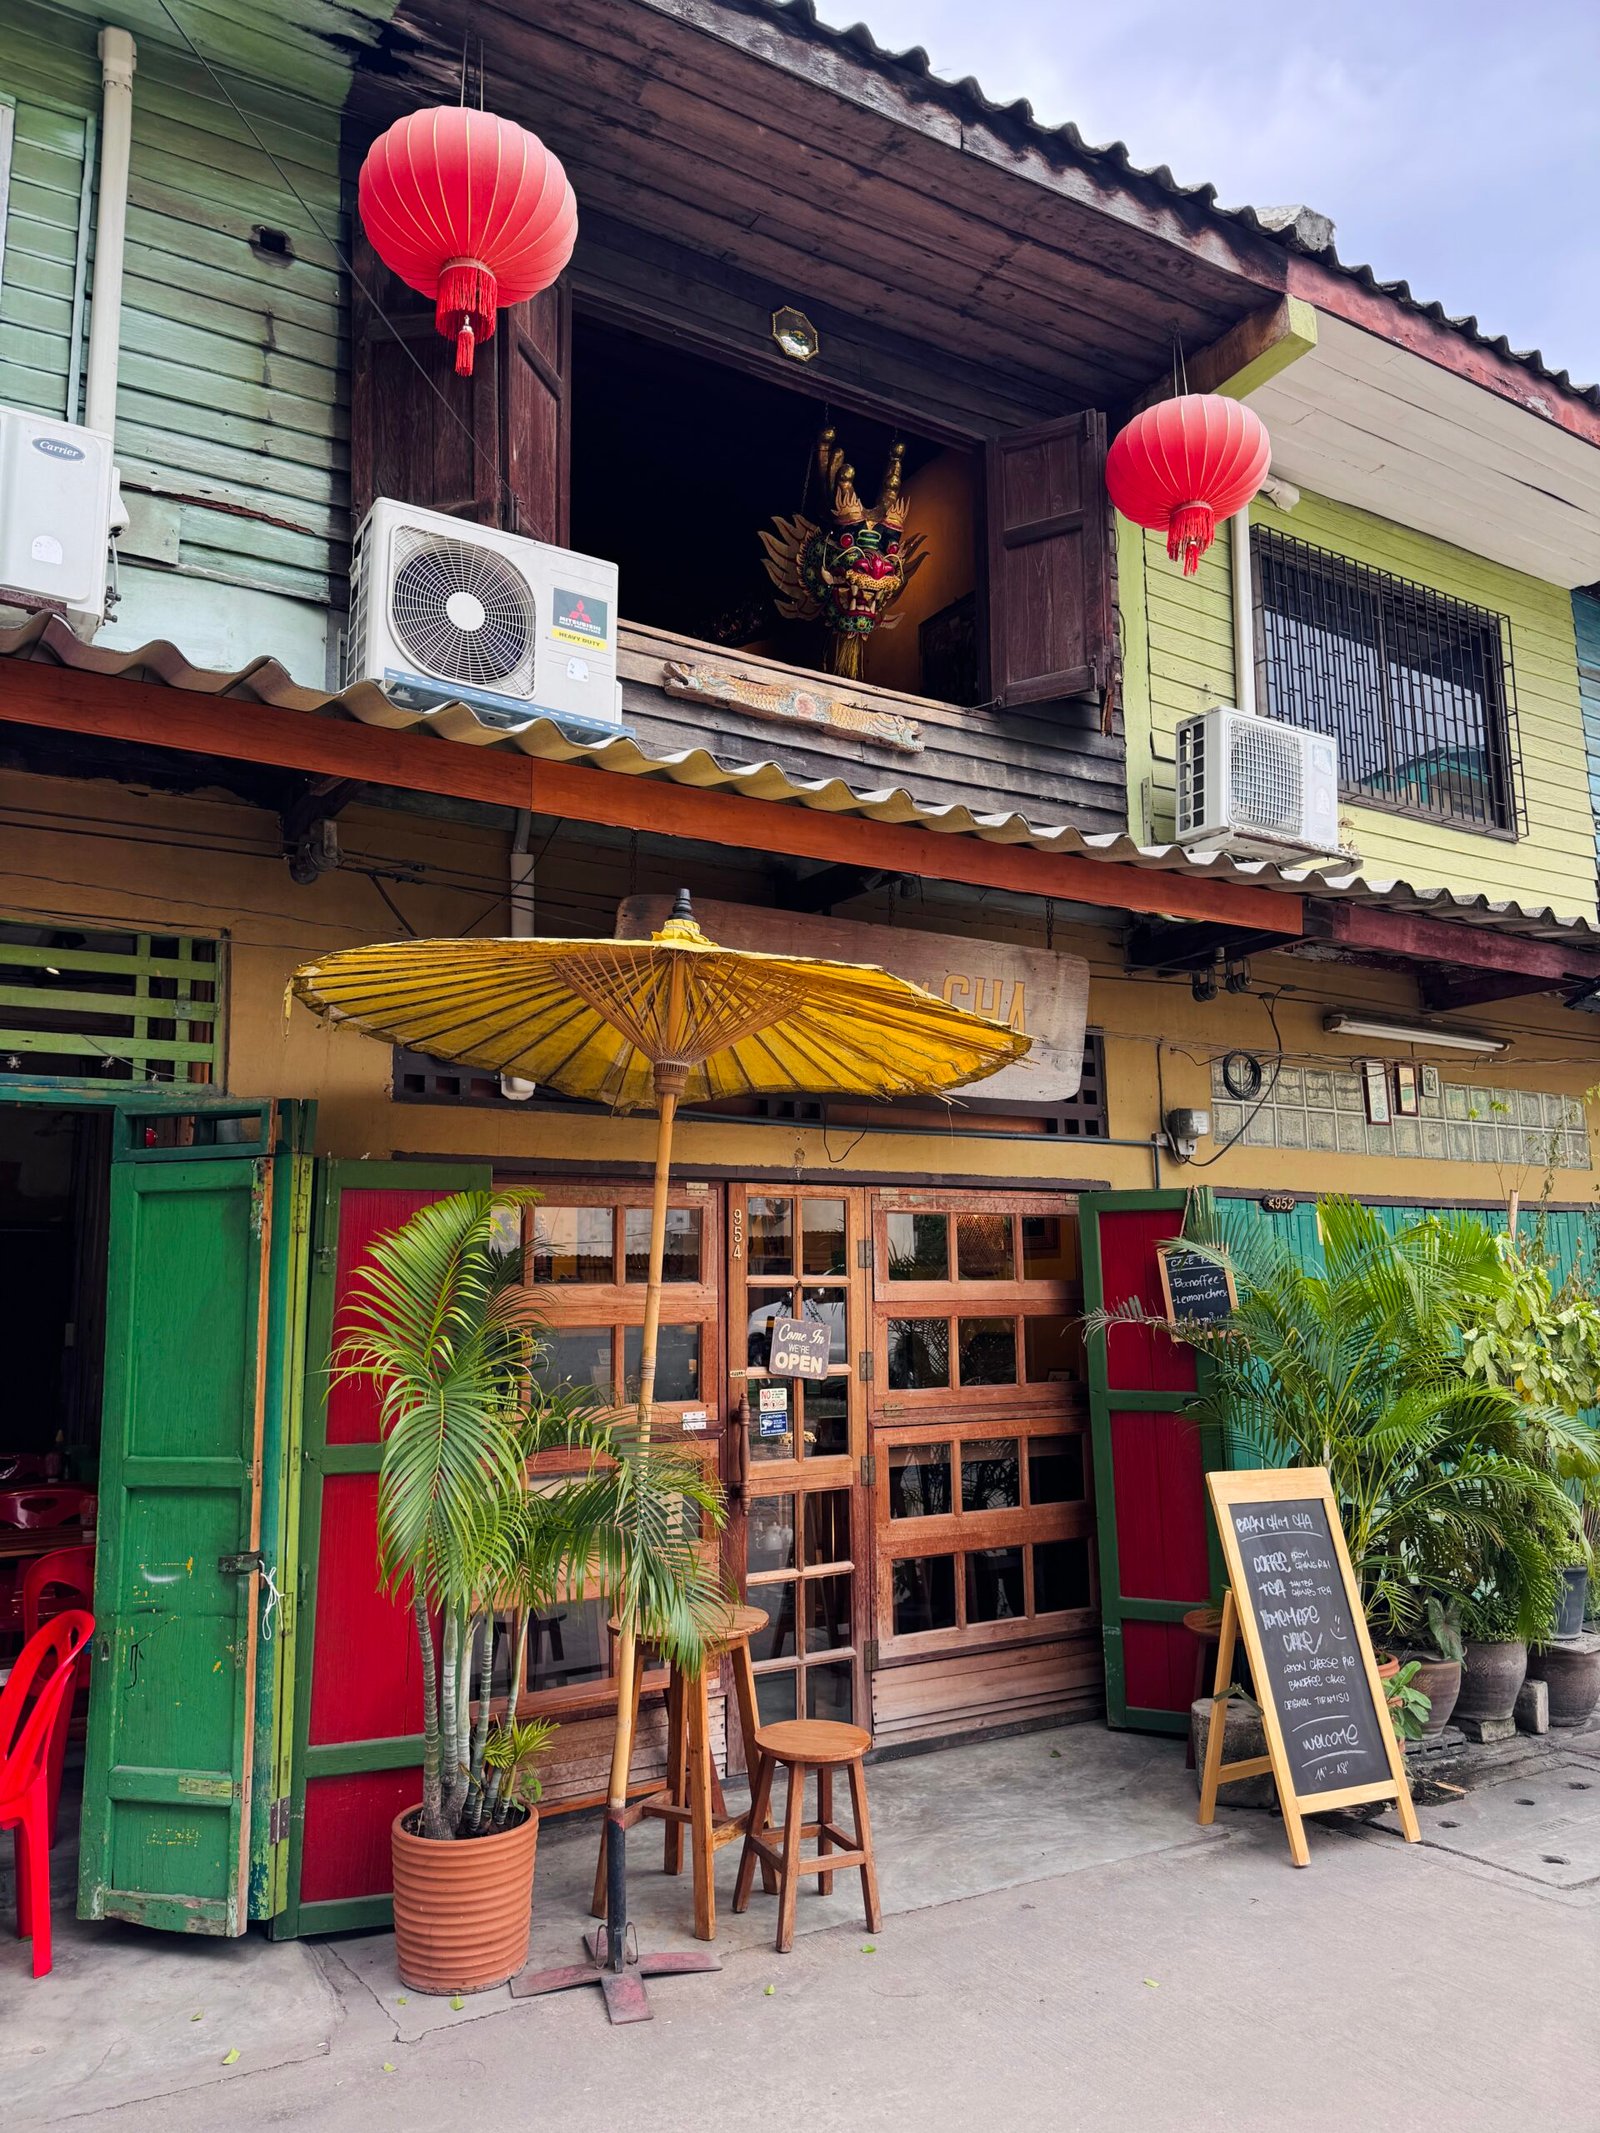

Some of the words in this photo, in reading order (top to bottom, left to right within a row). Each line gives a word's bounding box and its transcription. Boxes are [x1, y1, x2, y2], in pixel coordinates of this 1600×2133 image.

[40, 441, 79, 457] Carrier
[559, 632, 581, 642] HEAVY
[582, 638, 601, 647] DUTY
[943, 974, 1025, 1033] CHA
[733, 1208, 743, 1259] 954
[778, 1323, 807, 1342] Come
[809, 1329, 825, 1344] In
[788, 1343, 811, 1355] WE'RE
[775, 1351, 823, 1374] OPEN
[761, 1390, 772, 1400] NO
[1236, 1515, 1265, 1533] BAAN
[1292, 1513, 1313, 1529] CHA
[1253, 1551, 1291, 1573] COFFEE
[1259, 1579, 1287, 1599] TEA
[1283, 1630, 1323, 1655] CAKE
[1309, 1657, 1339, 1671] CHEESE
[1342, 1656, 1355, 1671] PIE
[1302, 1724, 1359, 1751] WELCOME
